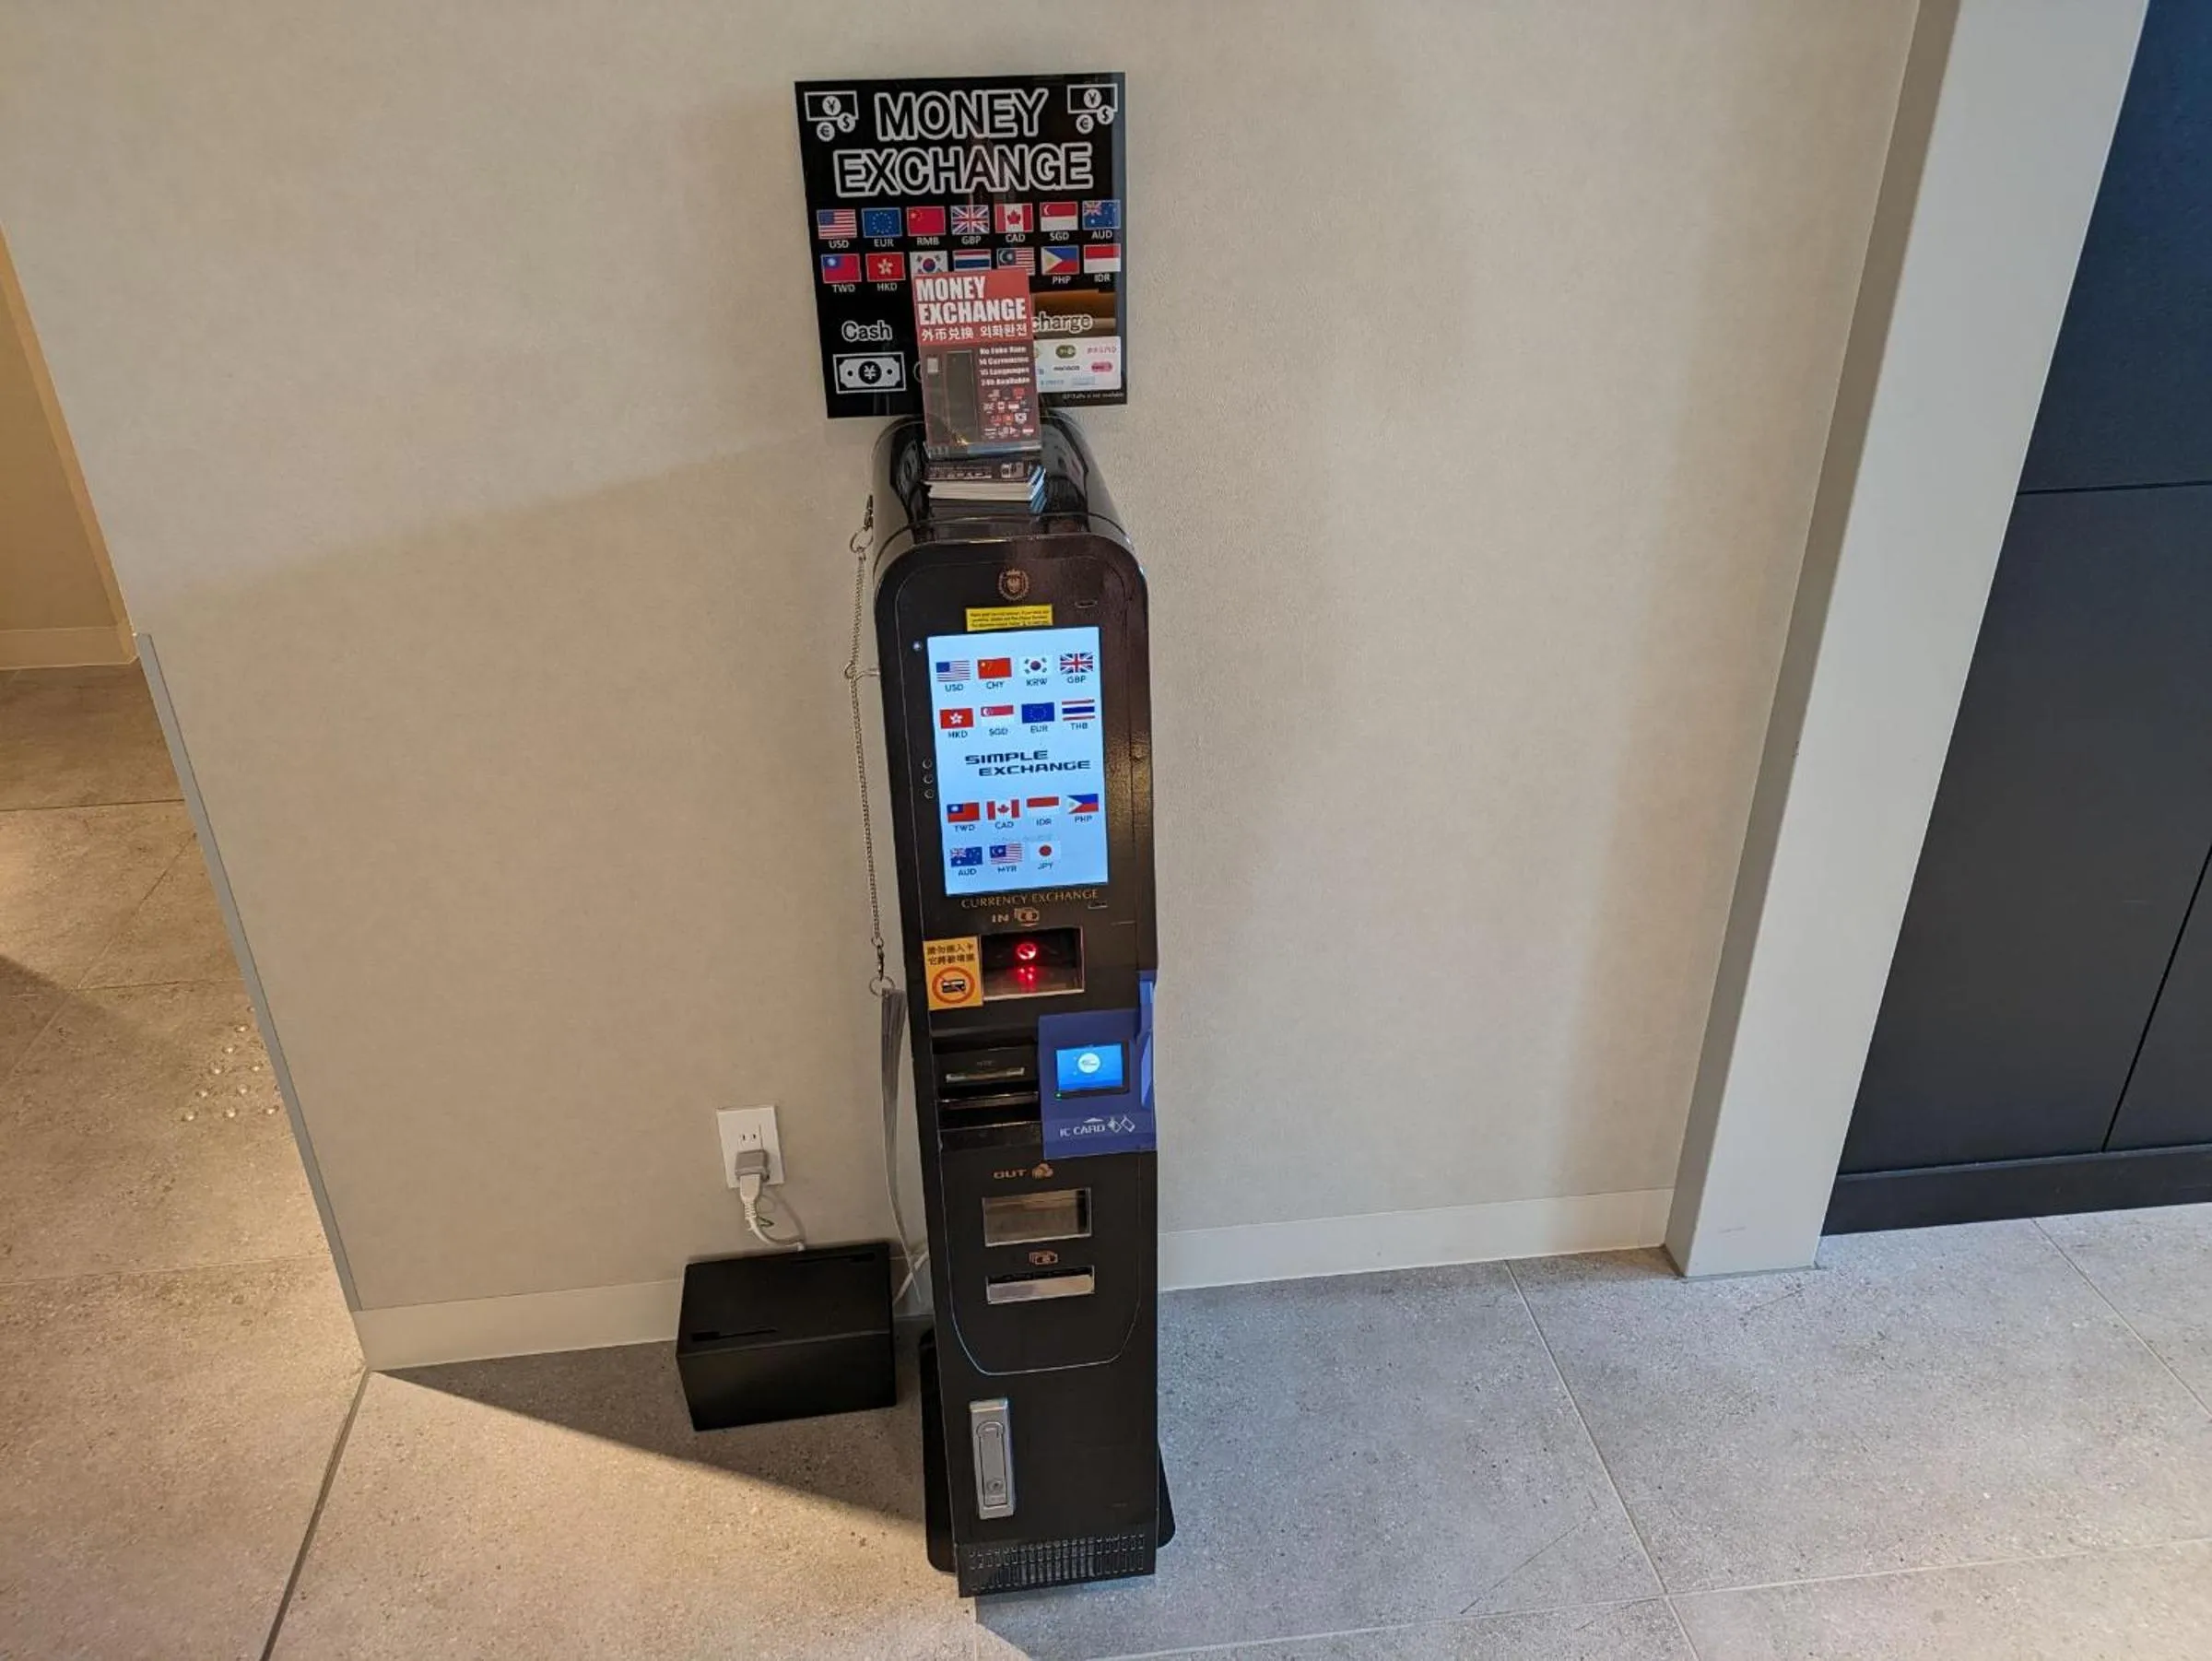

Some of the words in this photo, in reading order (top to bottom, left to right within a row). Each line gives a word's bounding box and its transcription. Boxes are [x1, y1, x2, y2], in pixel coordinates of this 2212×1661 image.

[875, 88, 1049, 141] MONEY
[833, 142, 1094, 197] EXCHANGE
[961, 235, 982, 244] GBP
[1005, 233, 1026, 242] CAD
[1049, 231, 1069, 241] SGD
[1091, 230, 1113, 240] AUD
[829, 240, 849, 249] USD
[874, 239, 894, 247] EUR
[916, 237, 940, 246] RMB
[1053, 276, 1072, 285] PHP
[1094, 274, 1112, 283] IDR
[831, 284, 855, 293] TWD
[877, 283, 898, 291] HKD
[914, 276, 986, 301] MONEY
[918, 298, 1027, 325] EXCHANGE
[841, 319, 892, 342] Cash
[1026, 677, 1048, 687] KRW
[1066, 676, 1087, 684] GBP
[945, 684, 964, 692] USD
[1030, 725, 1048, 734] EUR
[1071, 722, 1088, 730] THB
[947, 730, 968, 739] HKD
[989, 728, 1008, 736] SGD
[965, 749, 1049, 765] SIMPLE
[978, 760, 1092, 777] EXCHANGE
[1036, 818, 1052, 826] IDR
[1074, 815, 1093, 823] PHP
[955, 824, 975, 832] TWD
[994, 821, 1014, 830] CAD
[997, 866, 1018, 874] MYR
[1038, 862, 1053, 870] JPY
[958, 868, 977, 877] AUD
[960, 895, 1028, 909] CURRENCY
[1031, 889, 1099, 903] EXCHANGE
[992, 913, 1010, 923] IN
[1060, 1127, 1070, 1137] IC
[1073, 1124, 1106, 1136] CARD
[994, 1169, 1027, 1180] OUT
